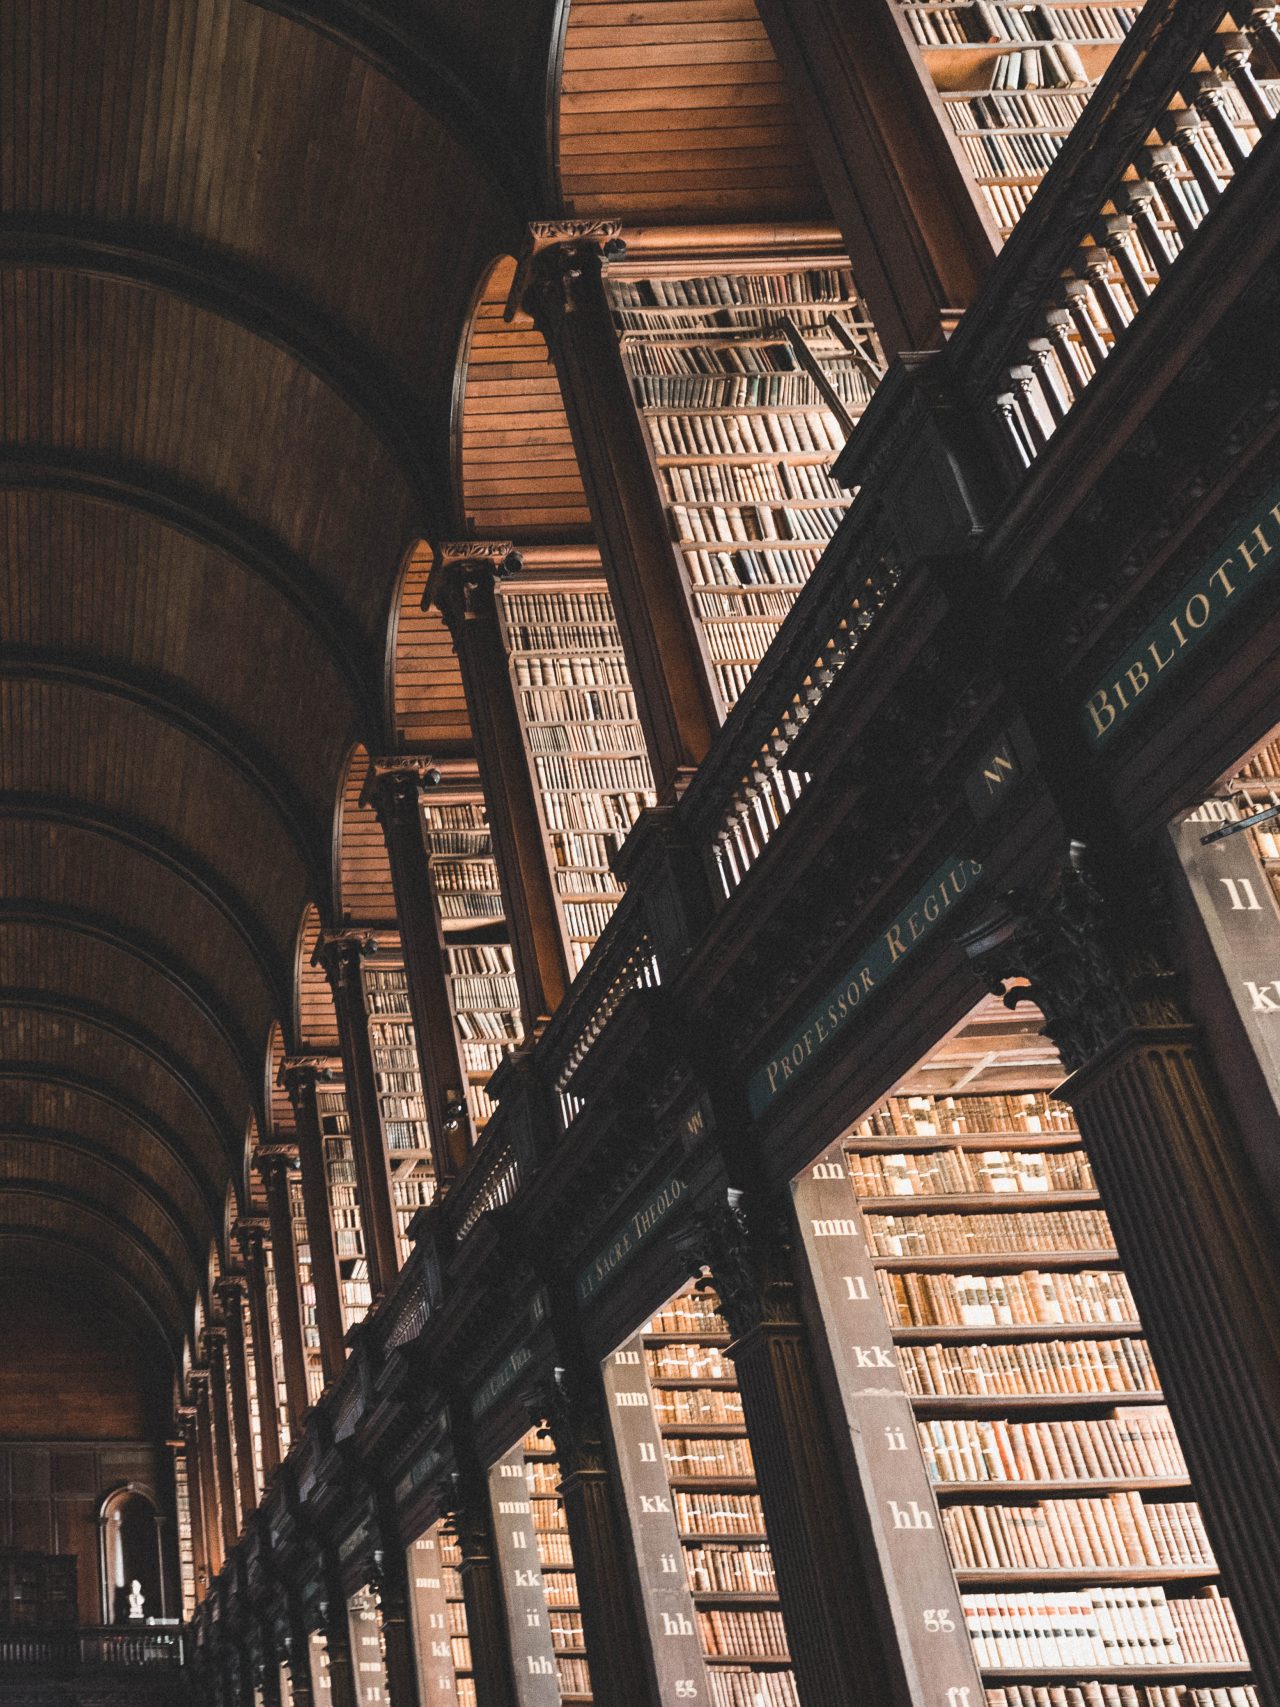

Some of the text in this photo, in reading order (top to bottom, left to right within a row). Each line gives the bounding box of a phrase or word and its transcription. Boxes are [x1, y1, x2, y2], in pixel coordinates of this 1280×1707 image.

[1220, 879, 1263, 910] ll
[765, 859, 982, 1093] PROFESSOR REGIUS
[811, 1220, 858, 1236] mm
[843, 1277, 869, 1299] ll
[615, 1352, 640, 1364] nn
[852, 1346, 896, 1367] kk
[614, 1392, 648, 1406] mm
[885, 1427, 908, 1450] ii
[639, 1443, 657, 1462] ll
[500, 1465, 524, 1477] nn
[499, 1501, 530, 1515] mm
[640, 1496, 672, 1513] kk
[888, 1501, 934, 1529] hh
[513, 1532, 526, 1548] ll
[661, 1554, 677, 1572] ii
[416, 1577, 440, 1588] mm
[515, 1570, 541, 1586] kk
[527, 1609, 540, 1626] ii
[661, 1612, 694, 1635] hh
[923, 1609, 955, 1632] gg
[431, 1641, 450, 1656] kk
[527, 1656, 553, 1674] hh
[675, 1680, 697, 1698] gg
